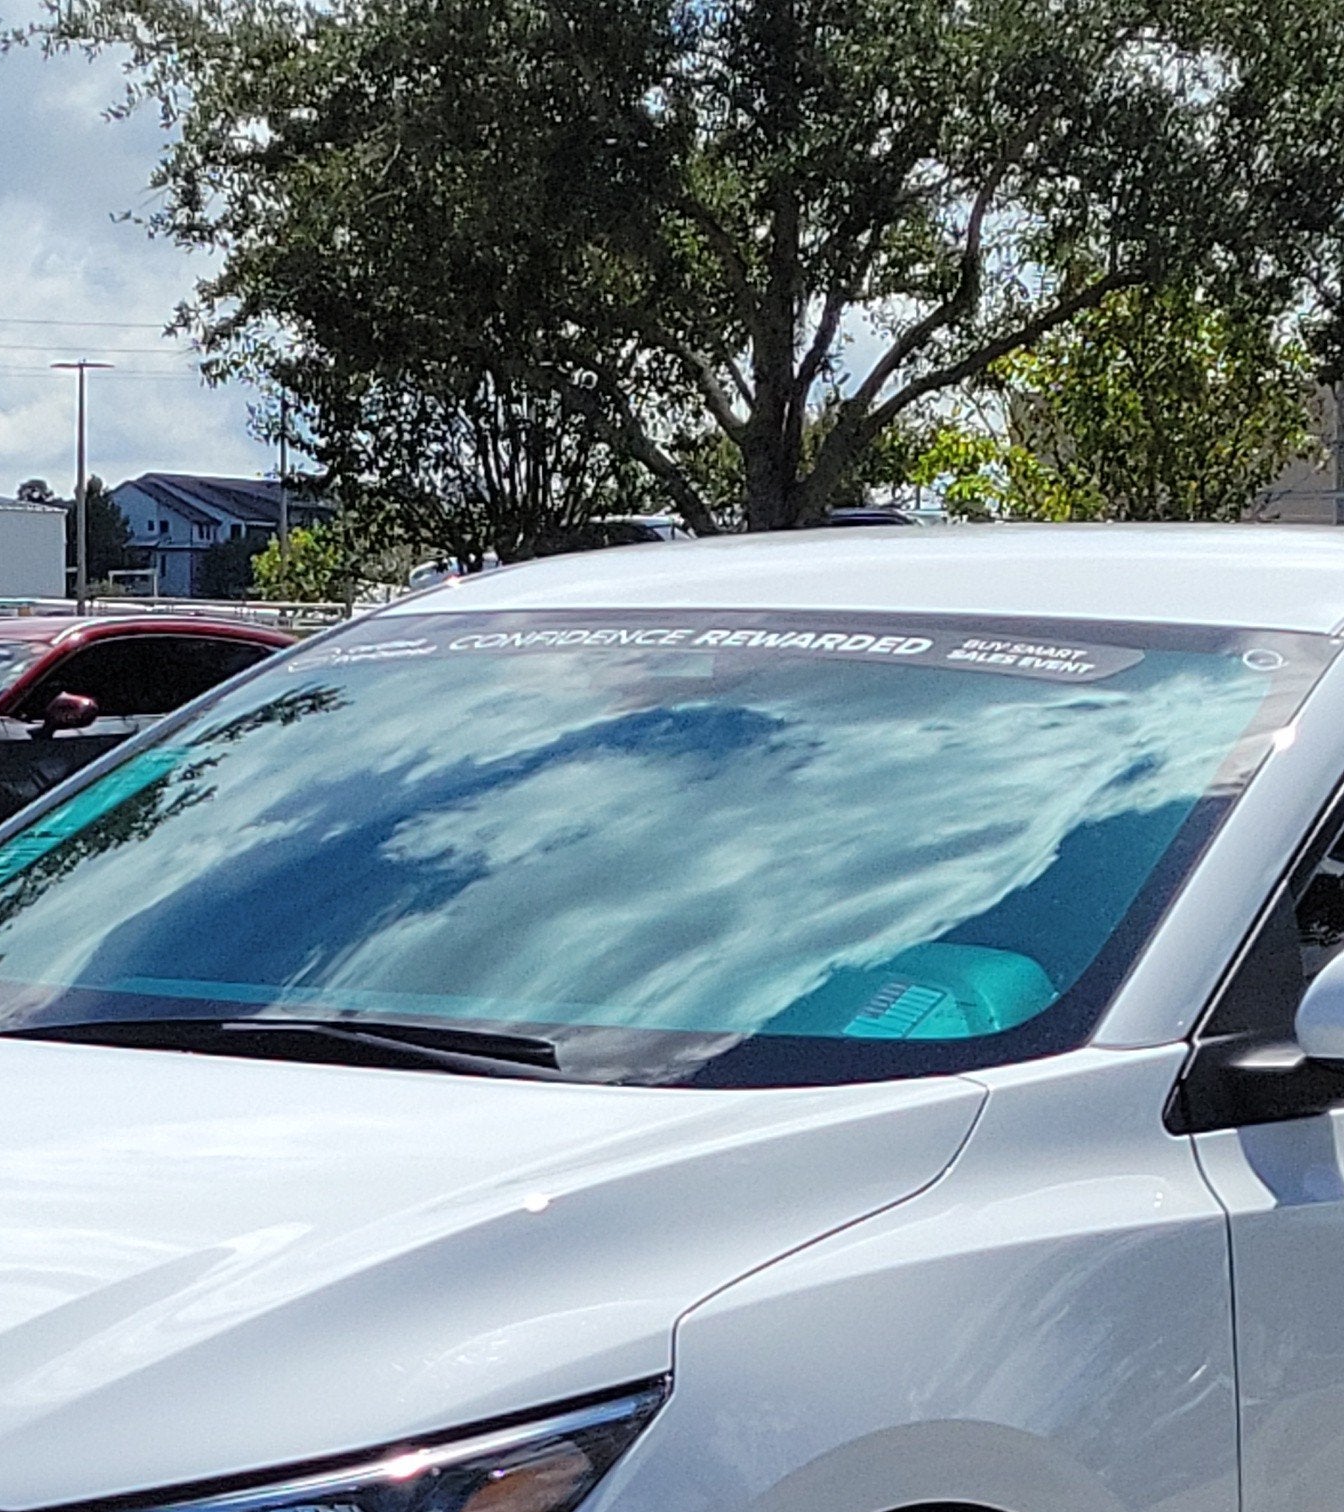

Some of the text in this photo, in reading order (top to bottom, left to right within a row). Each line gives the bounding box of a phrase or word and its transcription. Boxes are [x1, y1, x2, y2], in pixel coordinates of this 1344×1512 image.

[449, 629, 695, 650] CONFIDENCE
[693, 629, 934, 655] REWARDED
[962, 638, 1088, 661] BUY SMART
[946, 649, 1095, 675] SALES EVENT
